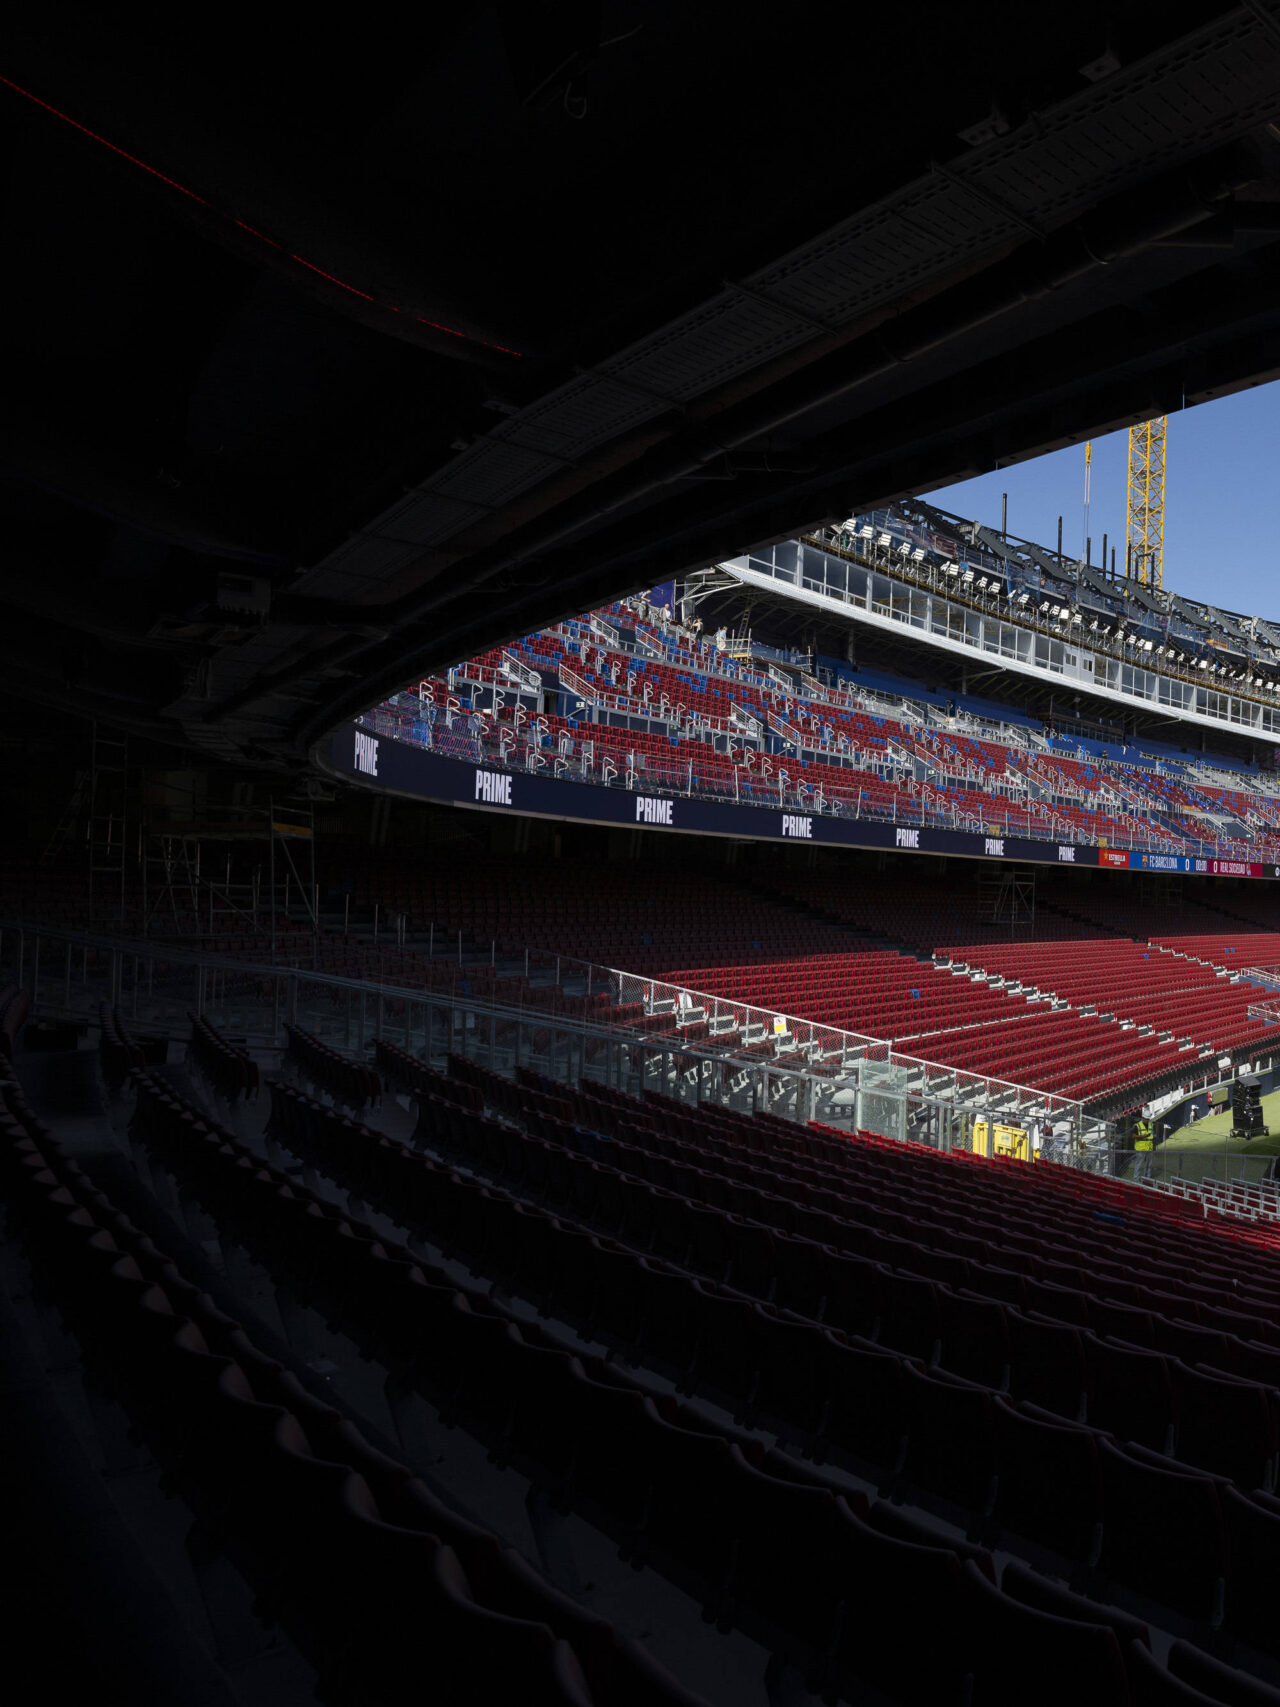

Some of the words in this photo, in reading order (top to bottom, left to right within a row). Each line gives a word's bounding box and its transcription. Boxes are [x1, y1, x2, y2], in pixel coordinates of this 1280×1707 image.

[354, 731, 379, 776] PRIME
[475, 769, 513, 805] PRIME
[635, 796, 674, 825] PRIME
[782, 814, 813, 839] PRIME
[896, 828, 920, 848] PRIME
[985, 839, 1005, 856] PRIME
[1059, 846, 1075, 861] PRIME
[1185, 859, 1190, 871] 0
[1213, 861, 1218, 873] 0
